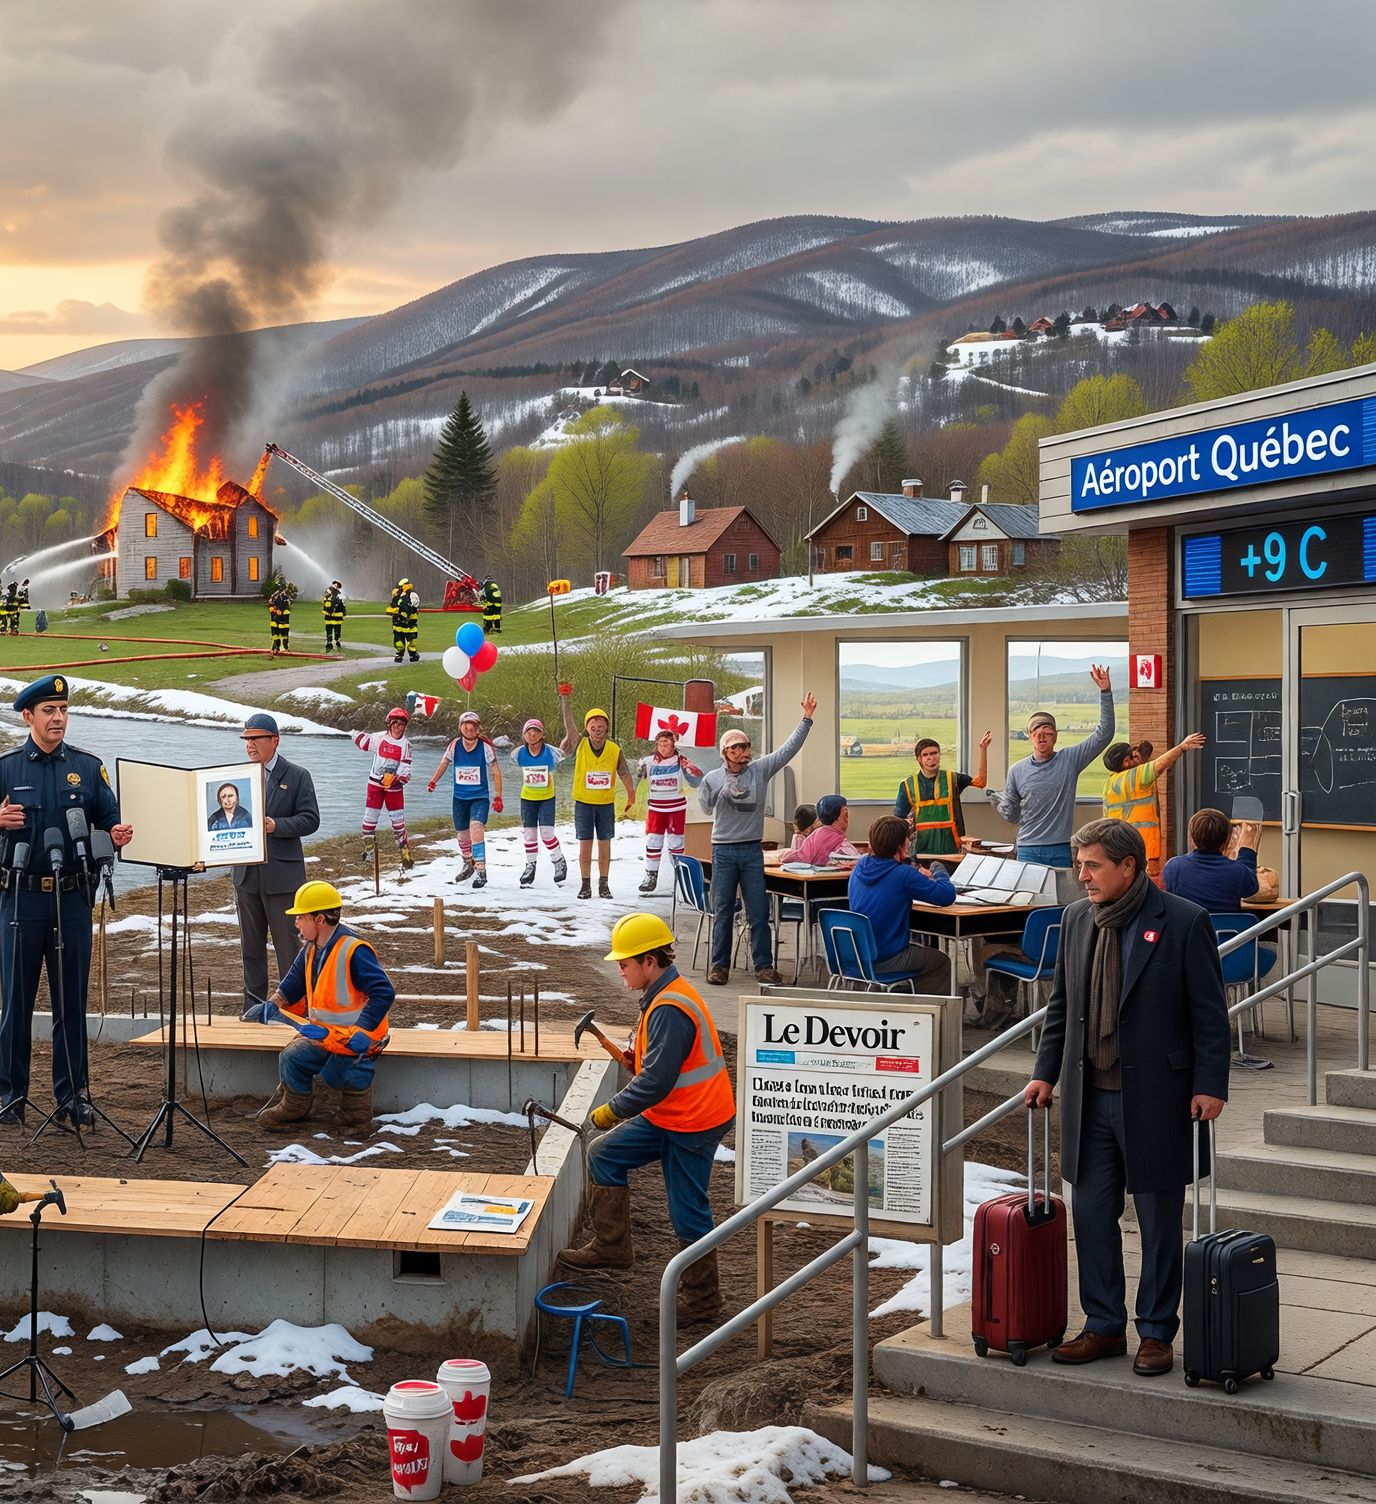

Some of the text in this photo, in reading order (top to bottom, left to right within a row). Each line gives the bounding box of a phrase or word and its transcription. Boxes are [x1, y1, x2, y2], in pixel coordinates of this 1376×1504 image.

[1080, 422, 1351, 497] Aéroport Québec
[1239, 525, 1328, 583] +9 C
[763, 1013, 906, 1050] Le Devoir
